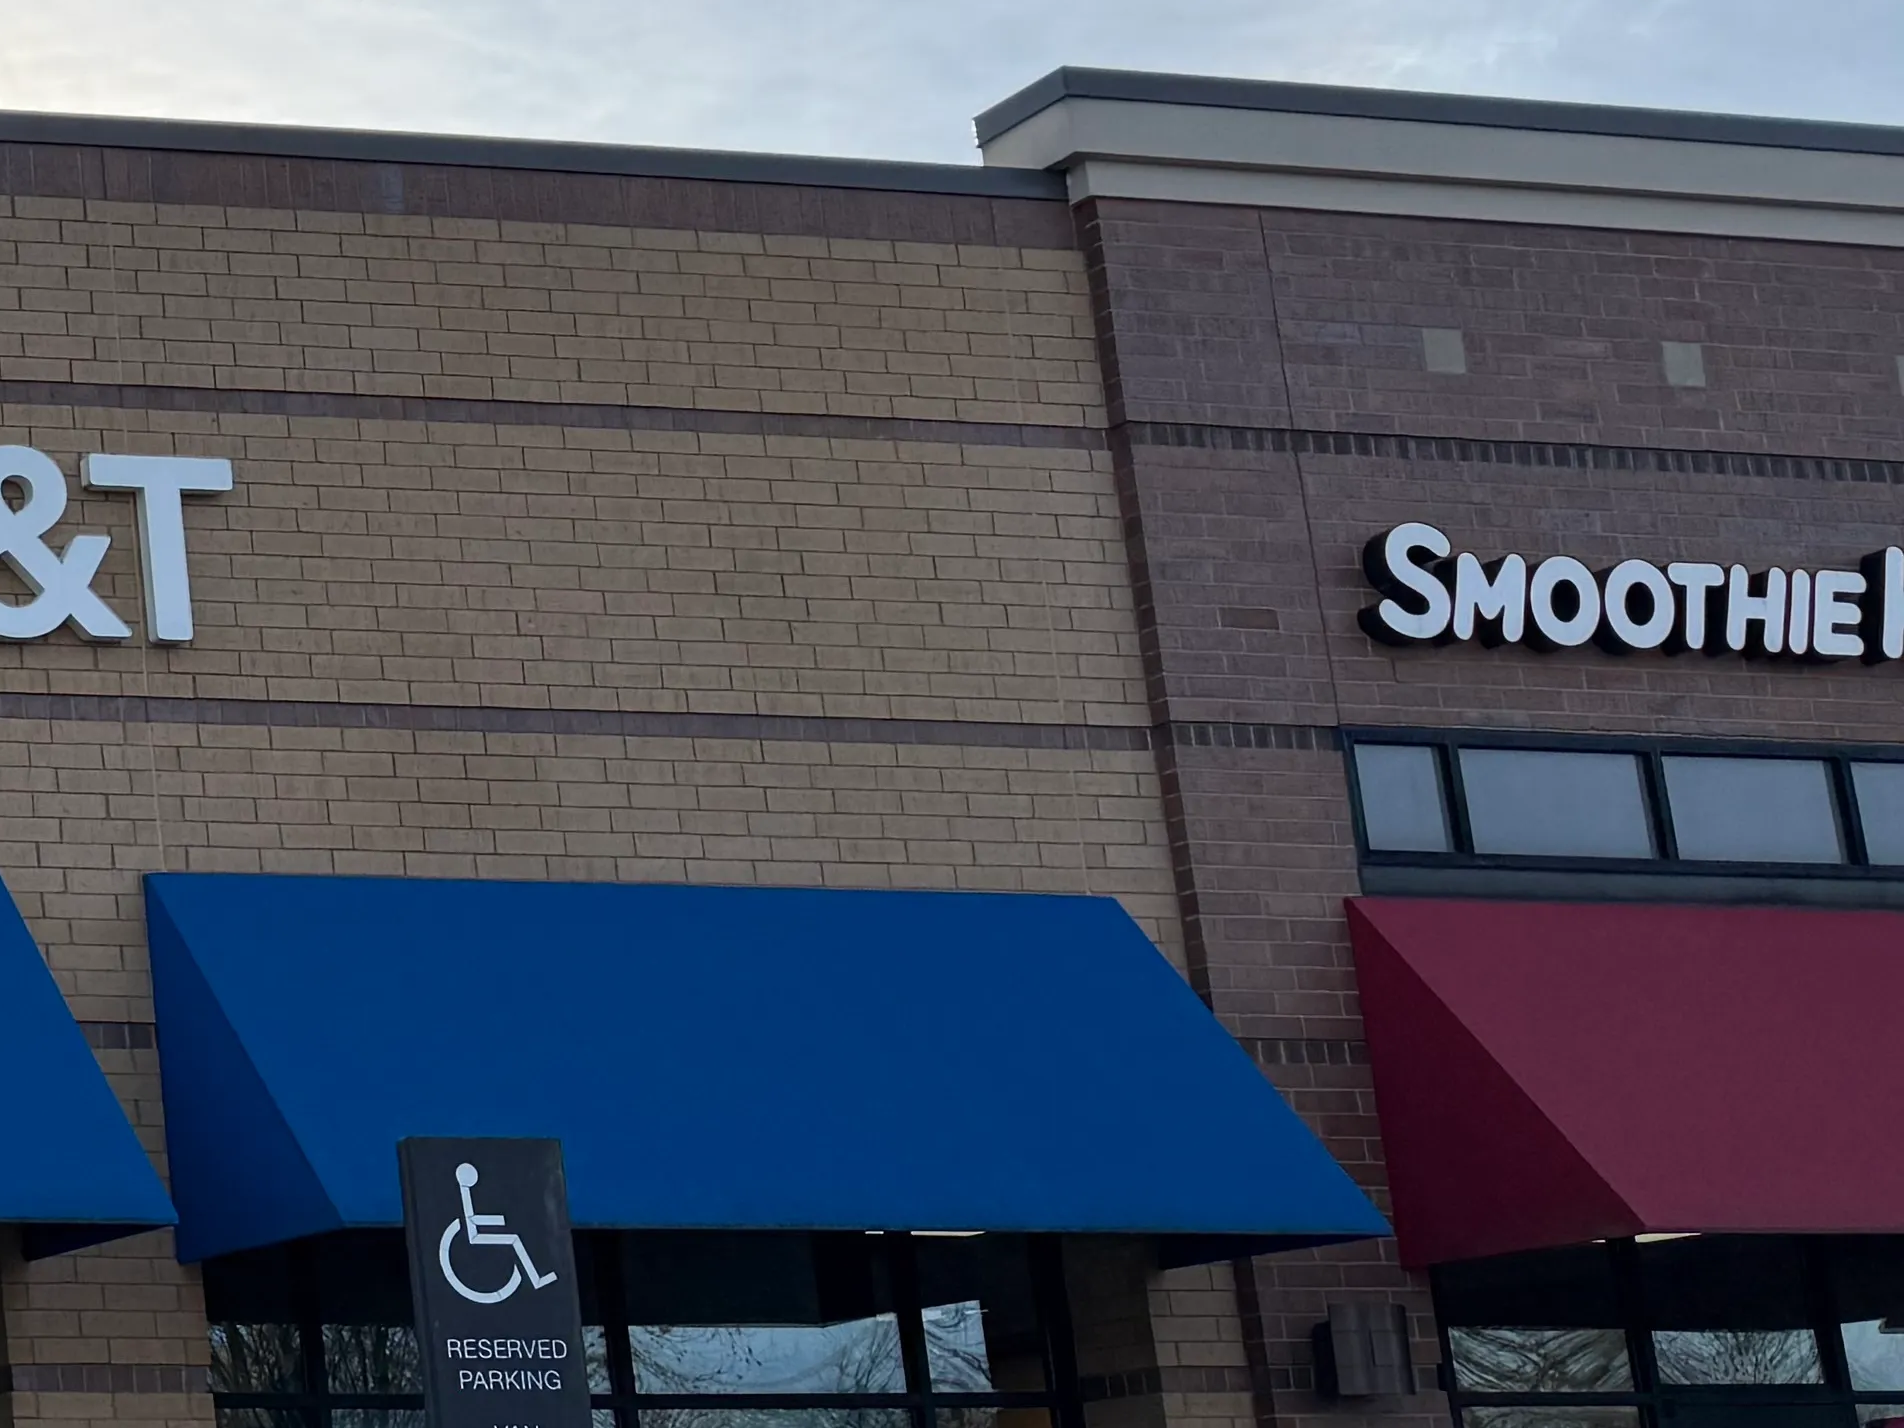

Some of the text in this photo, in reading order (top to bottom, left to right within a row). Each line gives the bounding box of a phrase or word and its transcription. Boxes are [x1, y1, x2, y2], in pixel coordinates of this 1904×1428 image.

[1374, 521, 1867, 657] SMOOTHIE
[446, 1338, 568, 1360] RESERVED
[458, 1369, 562, 1391] PARKING
